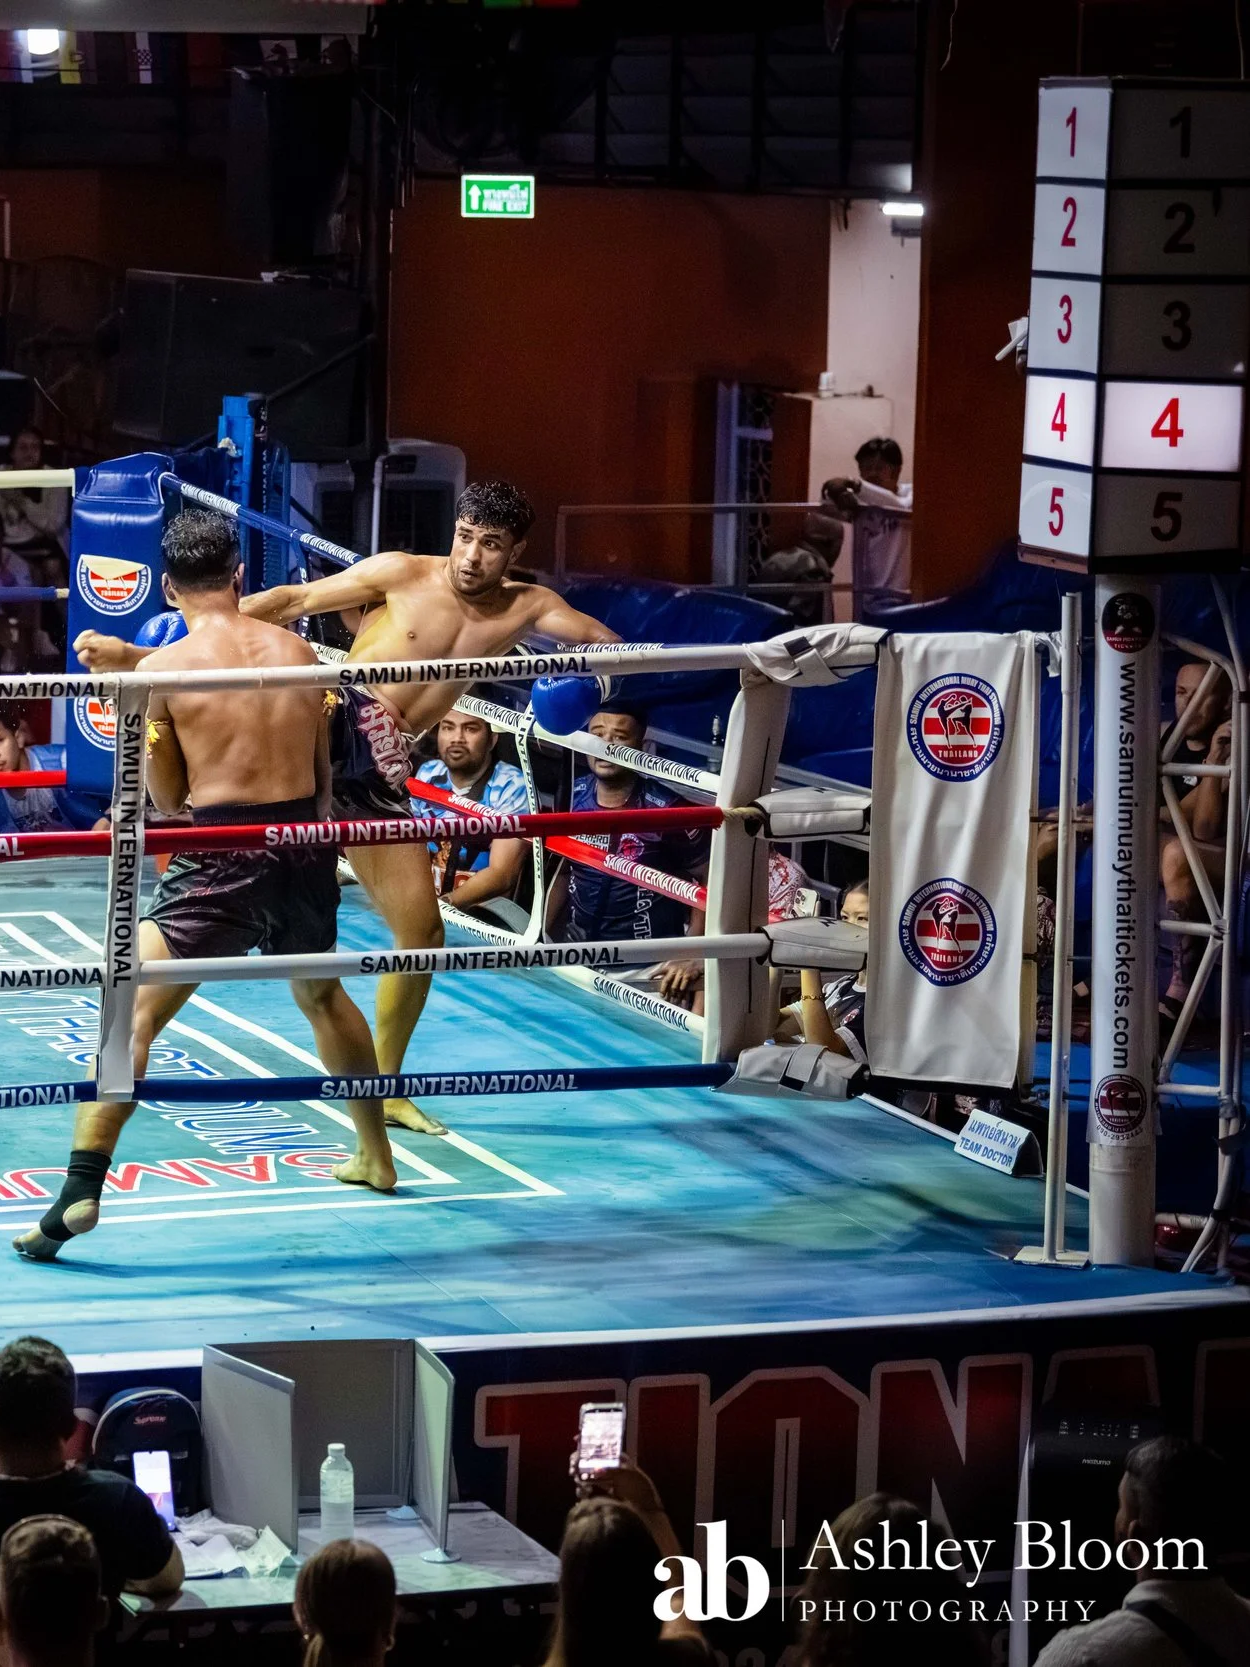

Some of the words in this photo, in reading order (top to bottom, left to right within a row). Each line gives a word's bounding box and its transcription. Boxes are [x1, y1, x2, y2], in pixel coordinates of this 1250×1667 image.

[1065, 106, 1078, 158] 1
[1169, 106, 1192, 159] 1
[1061, 197, 1077, 247] 2
[1163, 202, 1196, 254] 2
[1057, 294, 1072, 344] 3
[1161, 300, 1192, 352] 3
[1051, 392, 1067, 442] 4
[1150, 397, 1184, 448] 4
[1048, 487, 1064, 537] 5
[1150, 491, 1183, 542] 5
[339, 661, 412, 686] SAMUI
[420, 655, 593, 682] INTERNATIONAL
[909, 699, 923, 725] SAMUI
[122, 714, 142, 793] SAMUI
[605, 743, 634, 762] SAMUI
[632, 750, 701, 783] INTERNATIONAL
[265, 825, 341, 846] SAMUI
[347, 815, 527, 843] INTERNATIONAL
[603, 853, 634, 877] SAMUI
[631, 864, 702, 903] INTERNATIONAL
[1111, 662, 1139, 1069] www.samuimuaythaitickets.com
[113, 801, 138, 989] INTERNATIONAL
[360, 952, 438, 974] SAMUI
[445, 946, 625, 970] INTERNATIONAL
[593, 976, 623, 1002] SAMUI
[621, 988, 690, 1032] INTERNATIONAL
[320, 1077, 396, 1100] SAMUI
[403, 1073, 578, 1098] INTERNATIONAL
[960, 1136, 982, 1155] TEAM
[981, 1146, 1013, 1168] DOCTOR
